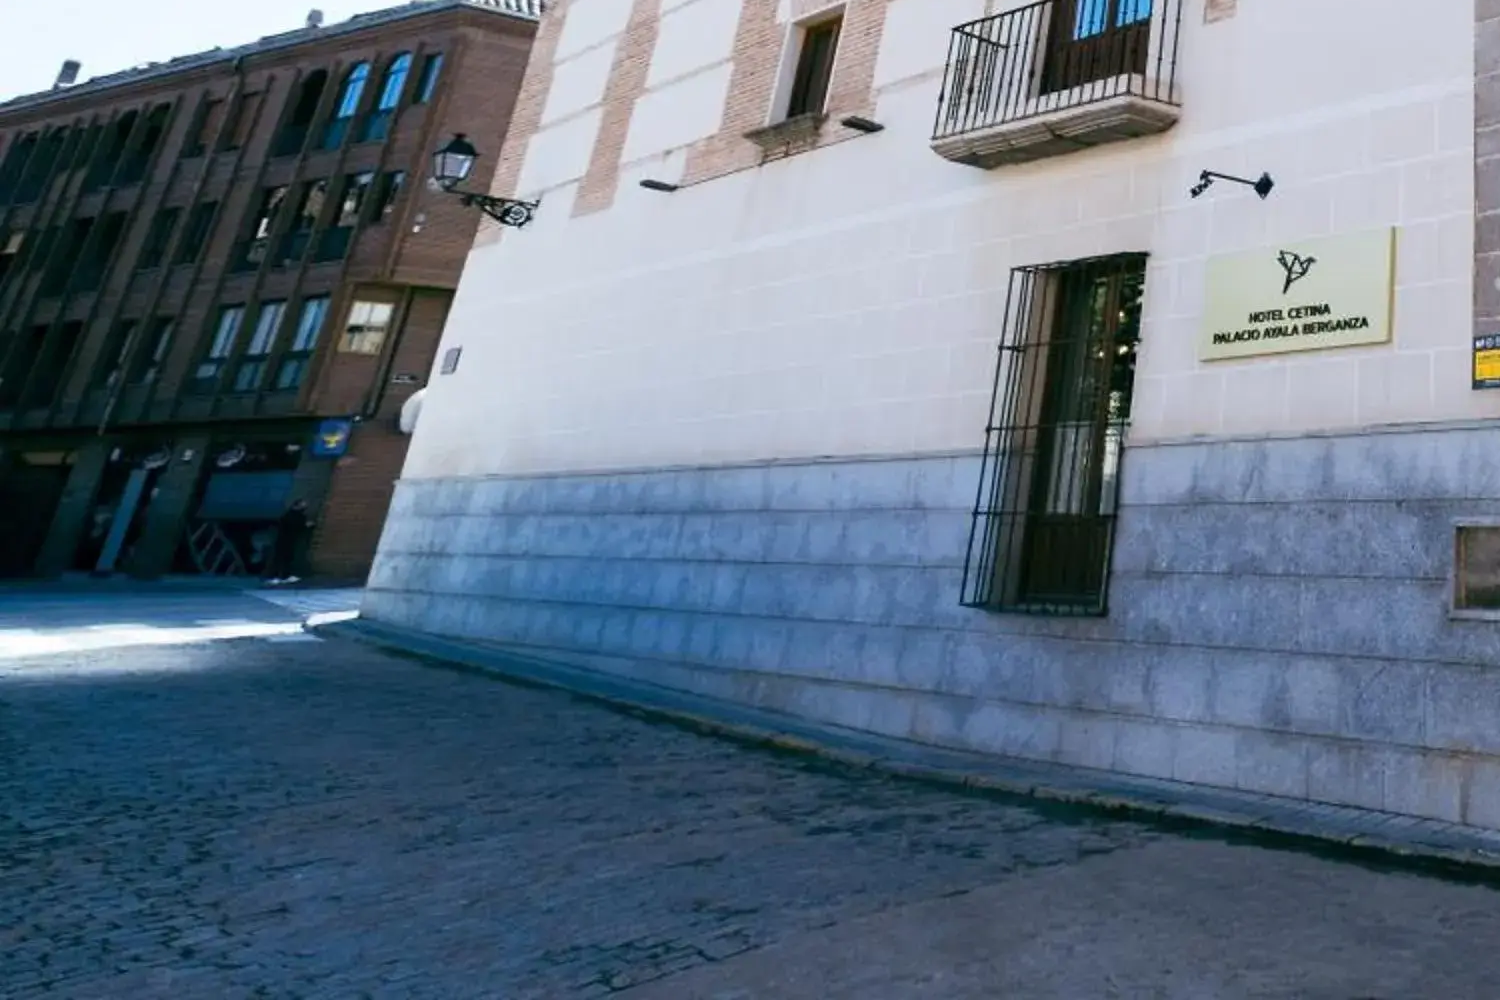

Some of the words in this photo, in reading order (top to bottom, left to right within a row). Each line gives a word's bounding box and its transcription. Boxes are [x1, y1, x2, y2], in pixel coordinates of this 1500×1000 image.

[1248, 309, 1284, 323] HOTEL
[1288, 304, 1331, 319] CETINA
[1212, 328, 1261, 345] PALACIO
[1263, 324, 1299, 339] AYALA
[1302, 316, 1369, 335] BERGANZA
